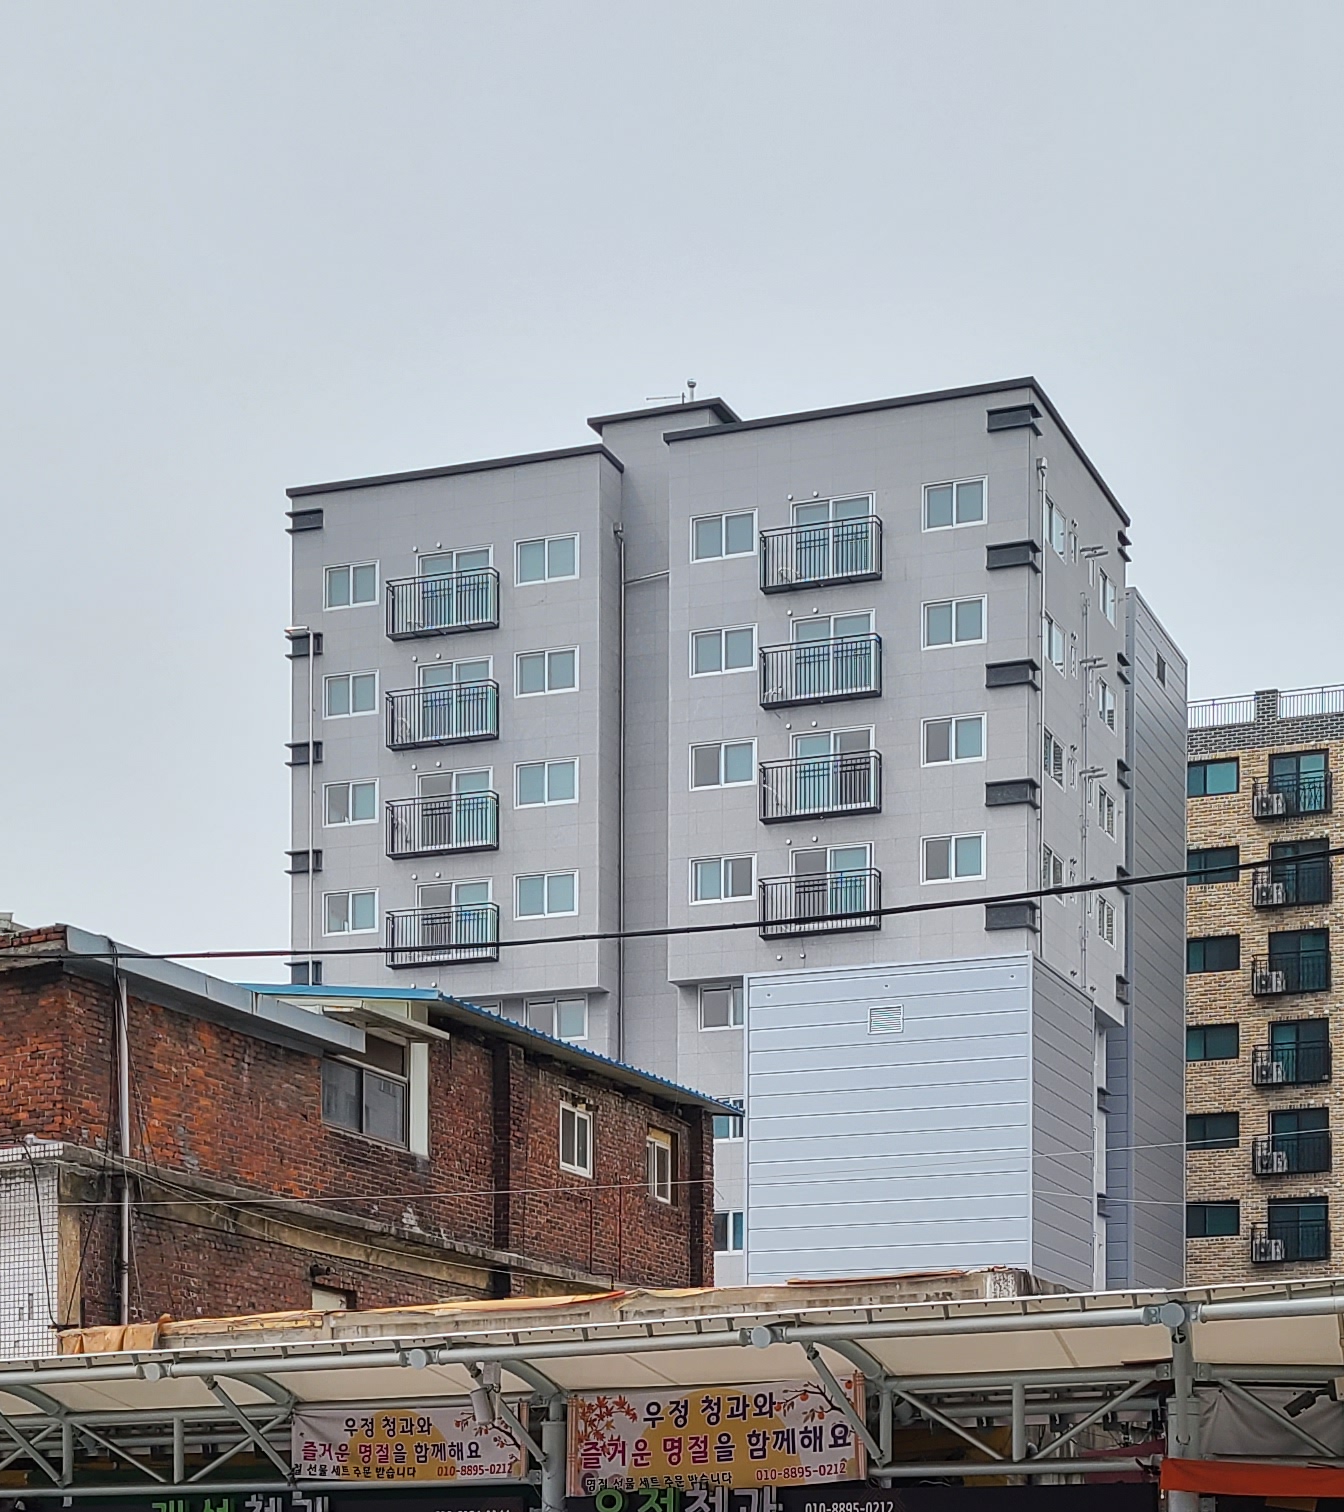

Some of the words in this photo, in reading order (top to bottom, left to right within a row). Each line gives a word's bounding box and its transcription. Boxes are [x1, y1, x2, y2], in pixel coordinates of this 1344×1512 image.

[643, 1399, 689, 1428] 우정
[701, 1391, 776, 1426] 청과와
[344, 1417, 375, 1438] 우정
[382, 1416, 432, 1436] 청과와
[302, 1442, 350, 1462] 즐거운
[359, 1443, 407, 1464] 명절을
[414, 1441, 481, 1463] 함께해요
[580, 1439, 652, 1470] 즐거운
[663, 1432, 736, 1466] 명절을
[747, 1423, 852, 1460] 함께해요
[307, 1464, 327, 1477] 선물
[331, 1465, 350, 1477] 세트
[353, 1465, 372, 1477] 주문
[375, 1466, 417, 1478] 받습니다
[437, 1463, 513, 1477] 010-8895-0212
[757, 1463, 847, 1481] 010-8895-0212
[613, 1475, 636, 1490] 선물
[639, 1475, 660, 1488] 세트
[664, 1474, 685, 1488] 주문
[688, 1472, 732, 1485] 받습니다
